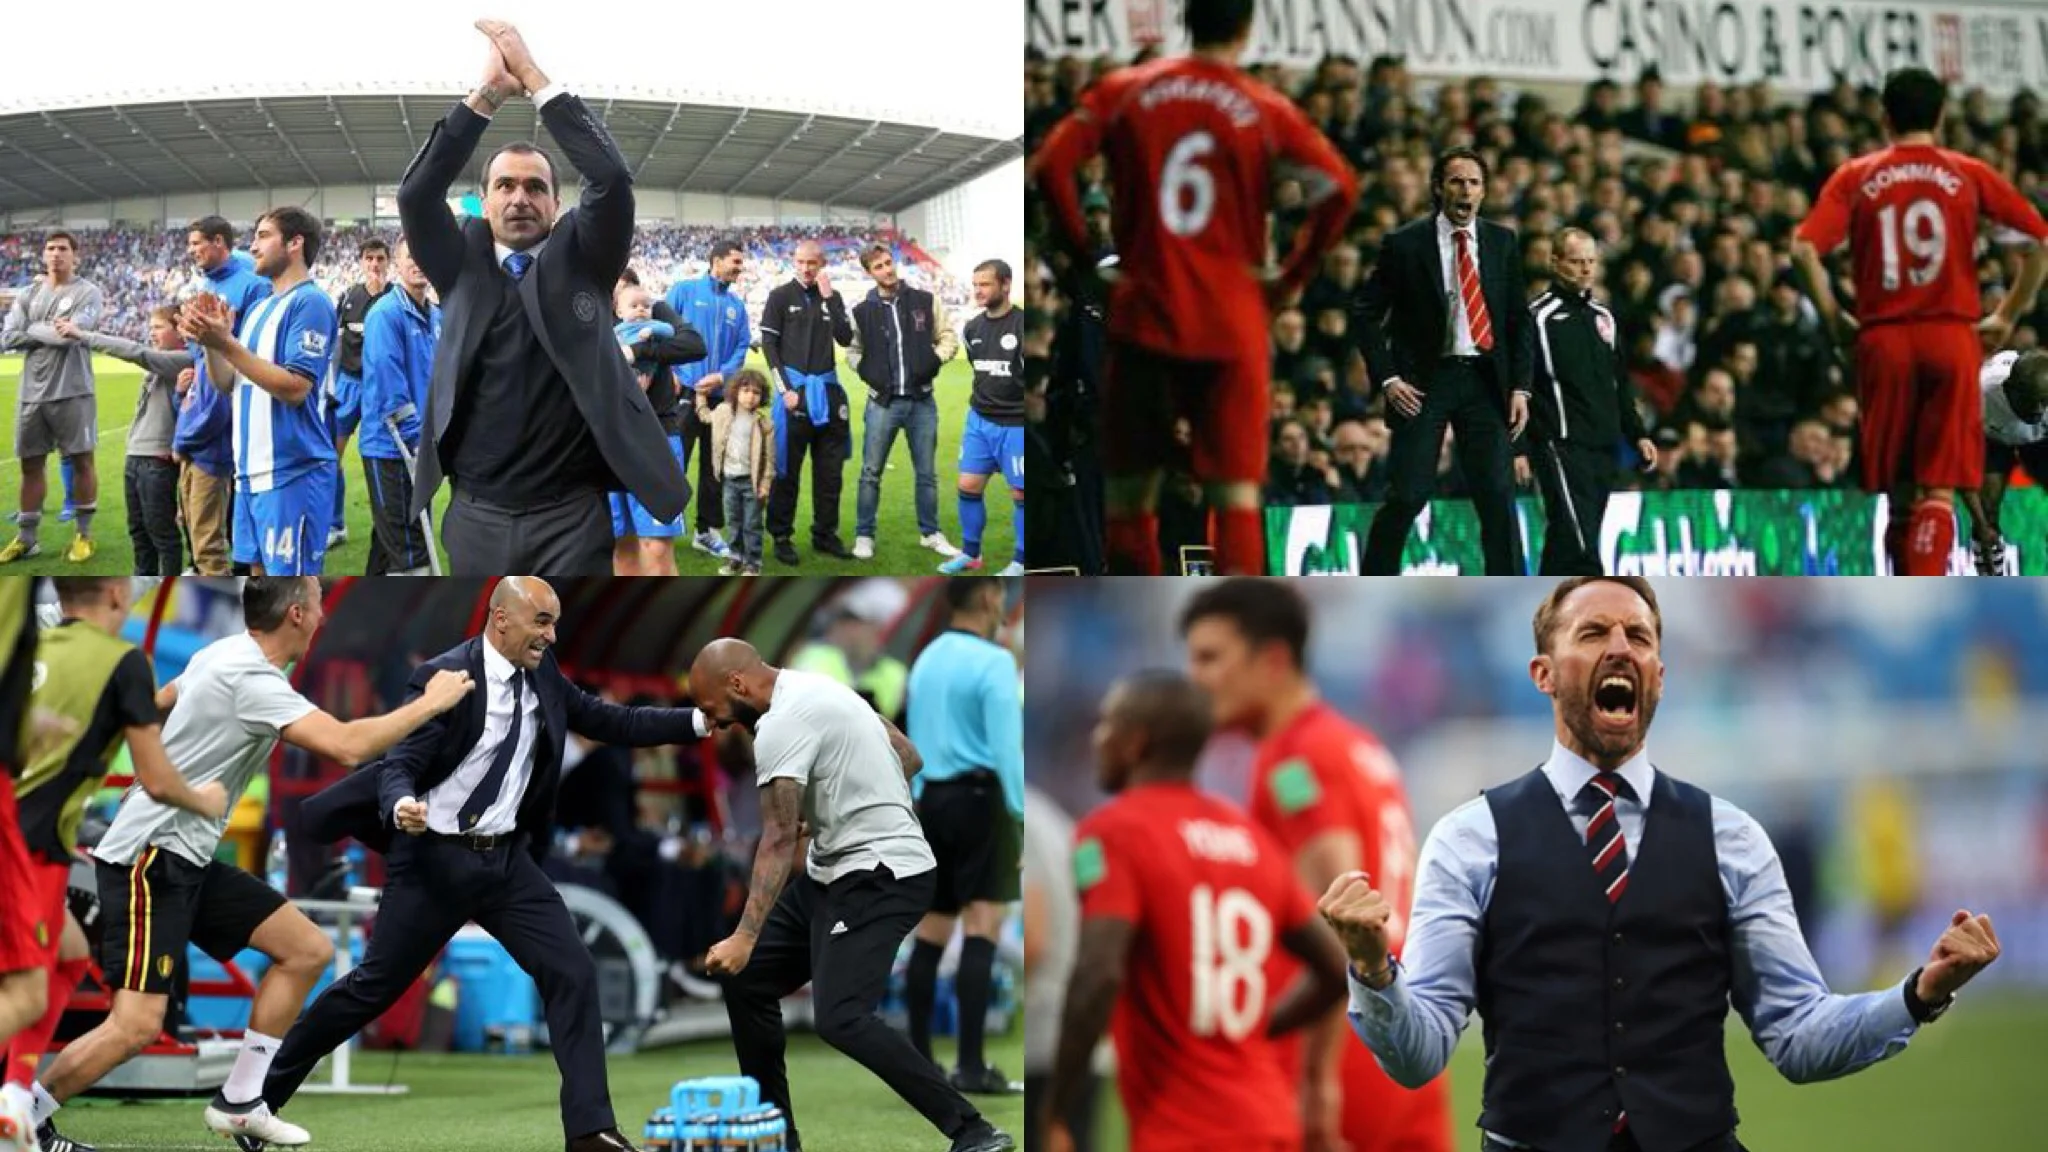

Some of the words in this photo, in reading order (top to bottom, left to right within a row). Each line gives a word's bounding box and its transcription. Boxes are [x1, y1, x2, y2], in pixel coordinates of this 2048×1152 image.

[1581, 0, 1746, 76] CASINO
[1760, 6, 1787, 77] &
[1798, 6, 1923, 84] POKER
[1159, 130, 1216, 237] 6
[1862, 163, 1962, 199] DOWNING
[1878, 199, 1947, 290] 19
[1190, 883, 1273, 1042] 18
